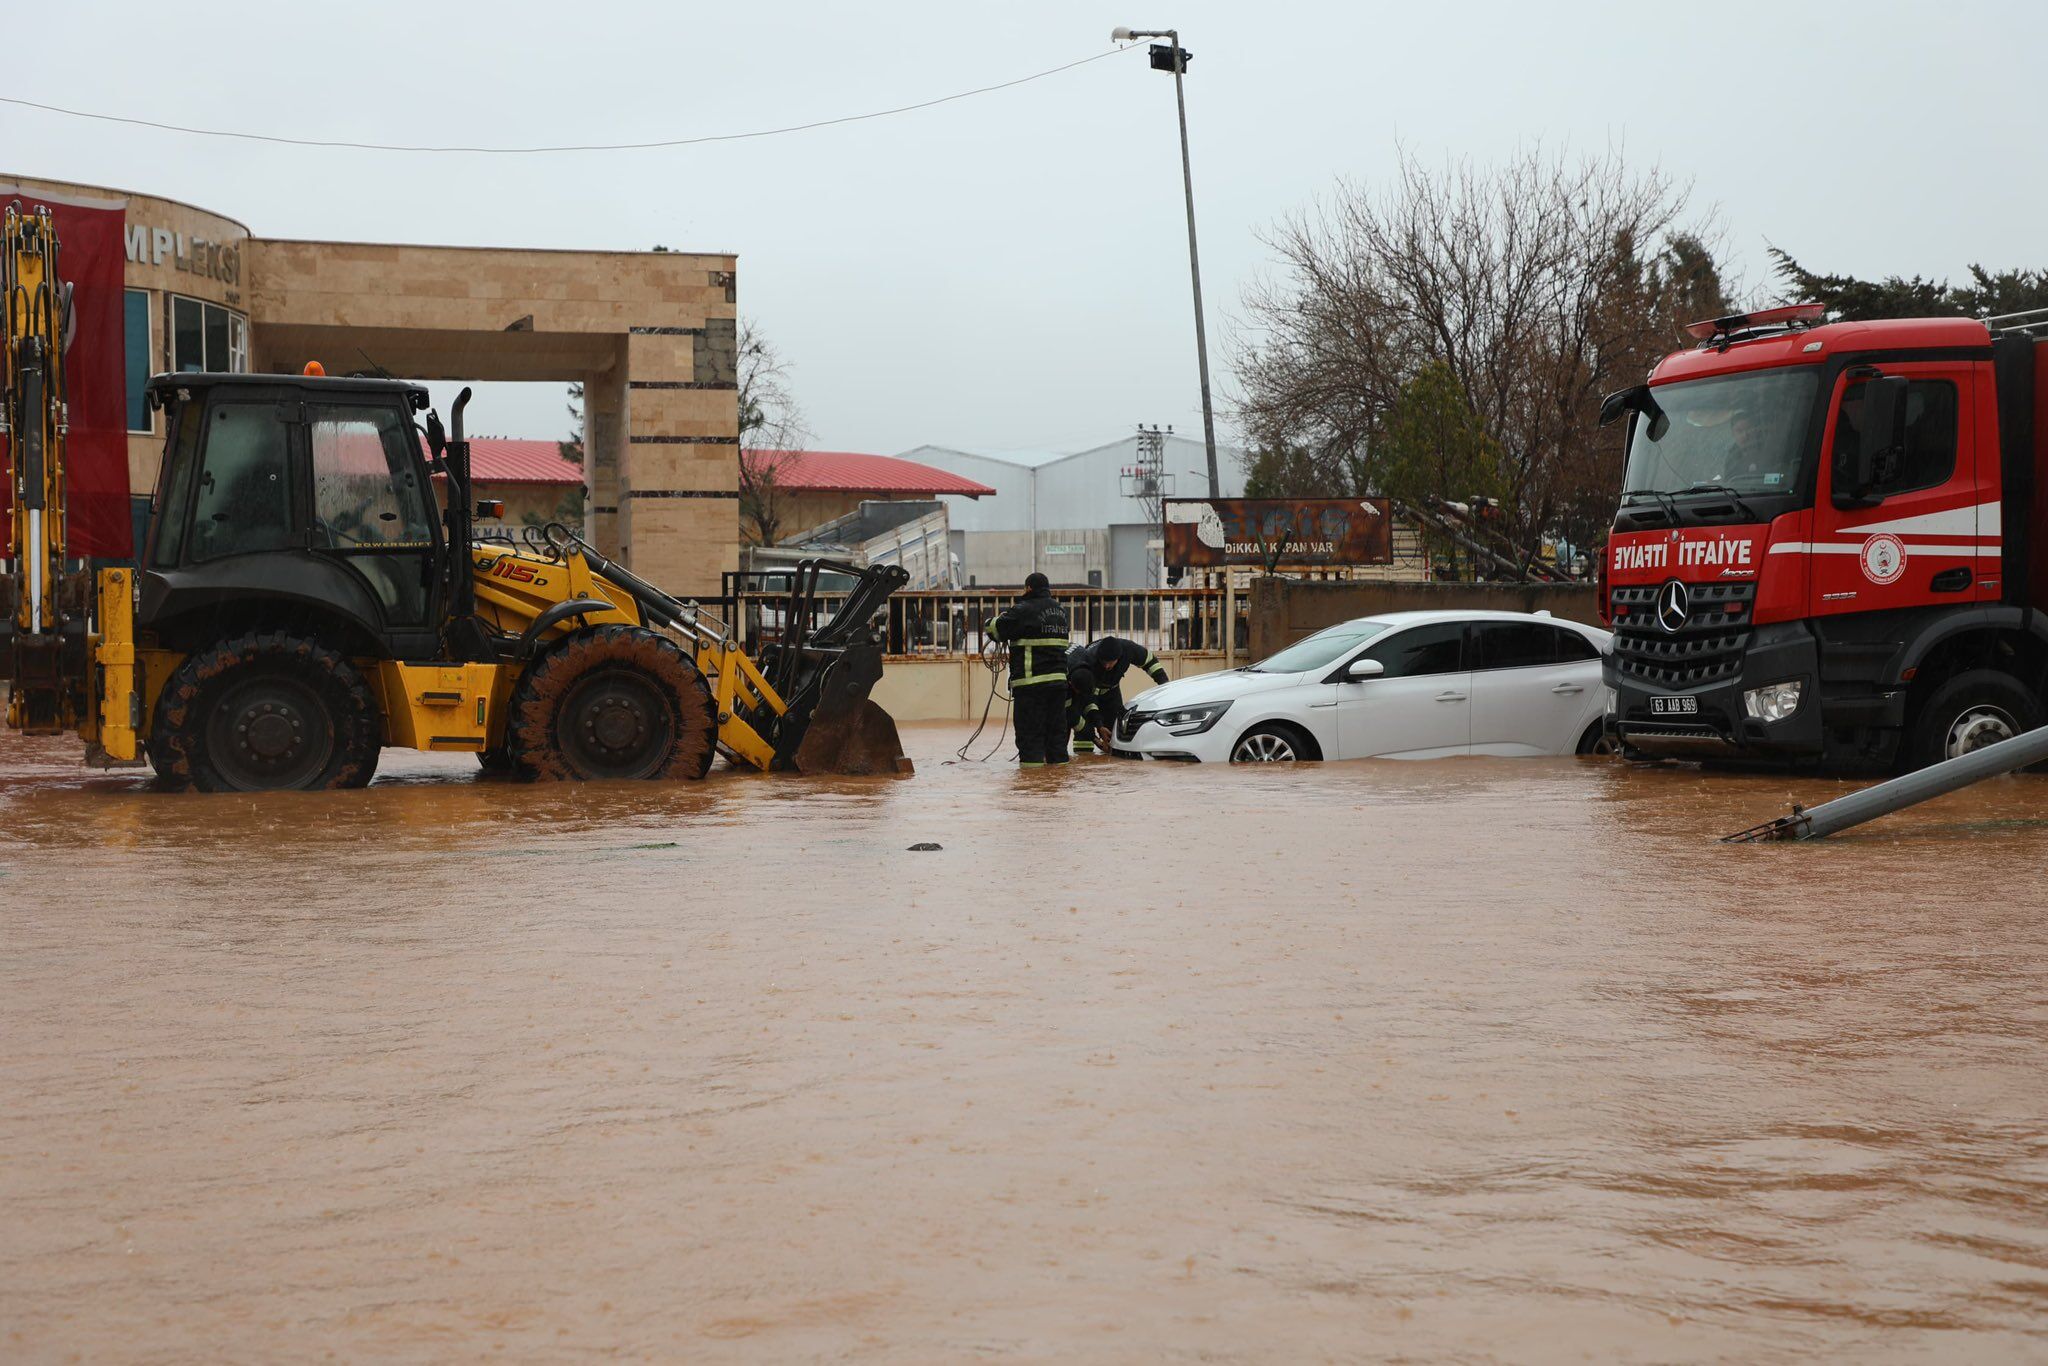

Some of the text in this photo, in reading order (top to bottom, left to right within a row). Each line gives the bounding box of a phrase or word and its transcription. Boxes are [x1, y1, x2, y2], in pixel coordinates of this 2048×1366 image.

[1225, 542, 1334, 553] DİKKA KPAN VAR
[1678, 533, 1752, 565] İTFAİYE
[1655, 699, 1663, 711] 63
[1667, 699, 1680, 711] AAB
